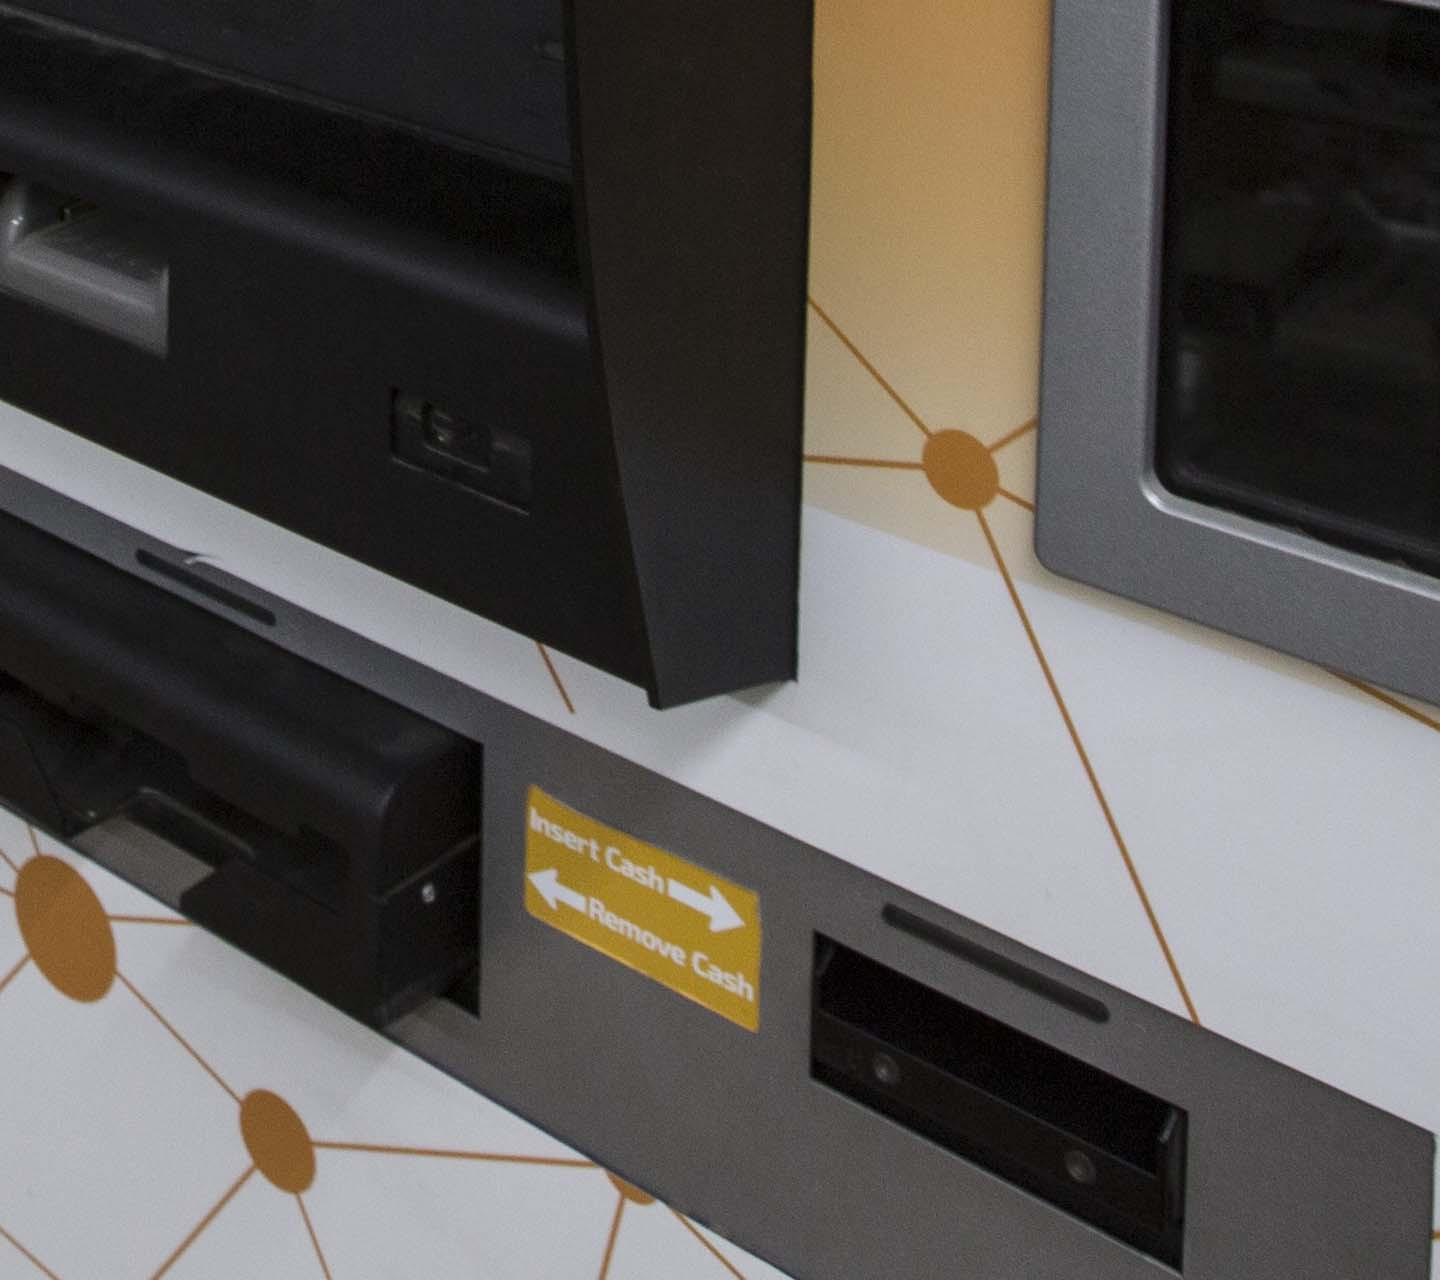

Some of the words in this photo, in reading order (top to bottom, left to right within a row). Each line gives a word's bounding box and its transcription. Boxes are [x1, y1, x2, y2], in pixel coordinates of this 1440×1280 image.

[529, 807, 600, 862] Insert
[604, 845, 665, 893] Cash
[588, 897, 687, 966] Remove
[691, 950, 755, 1002] Cash
